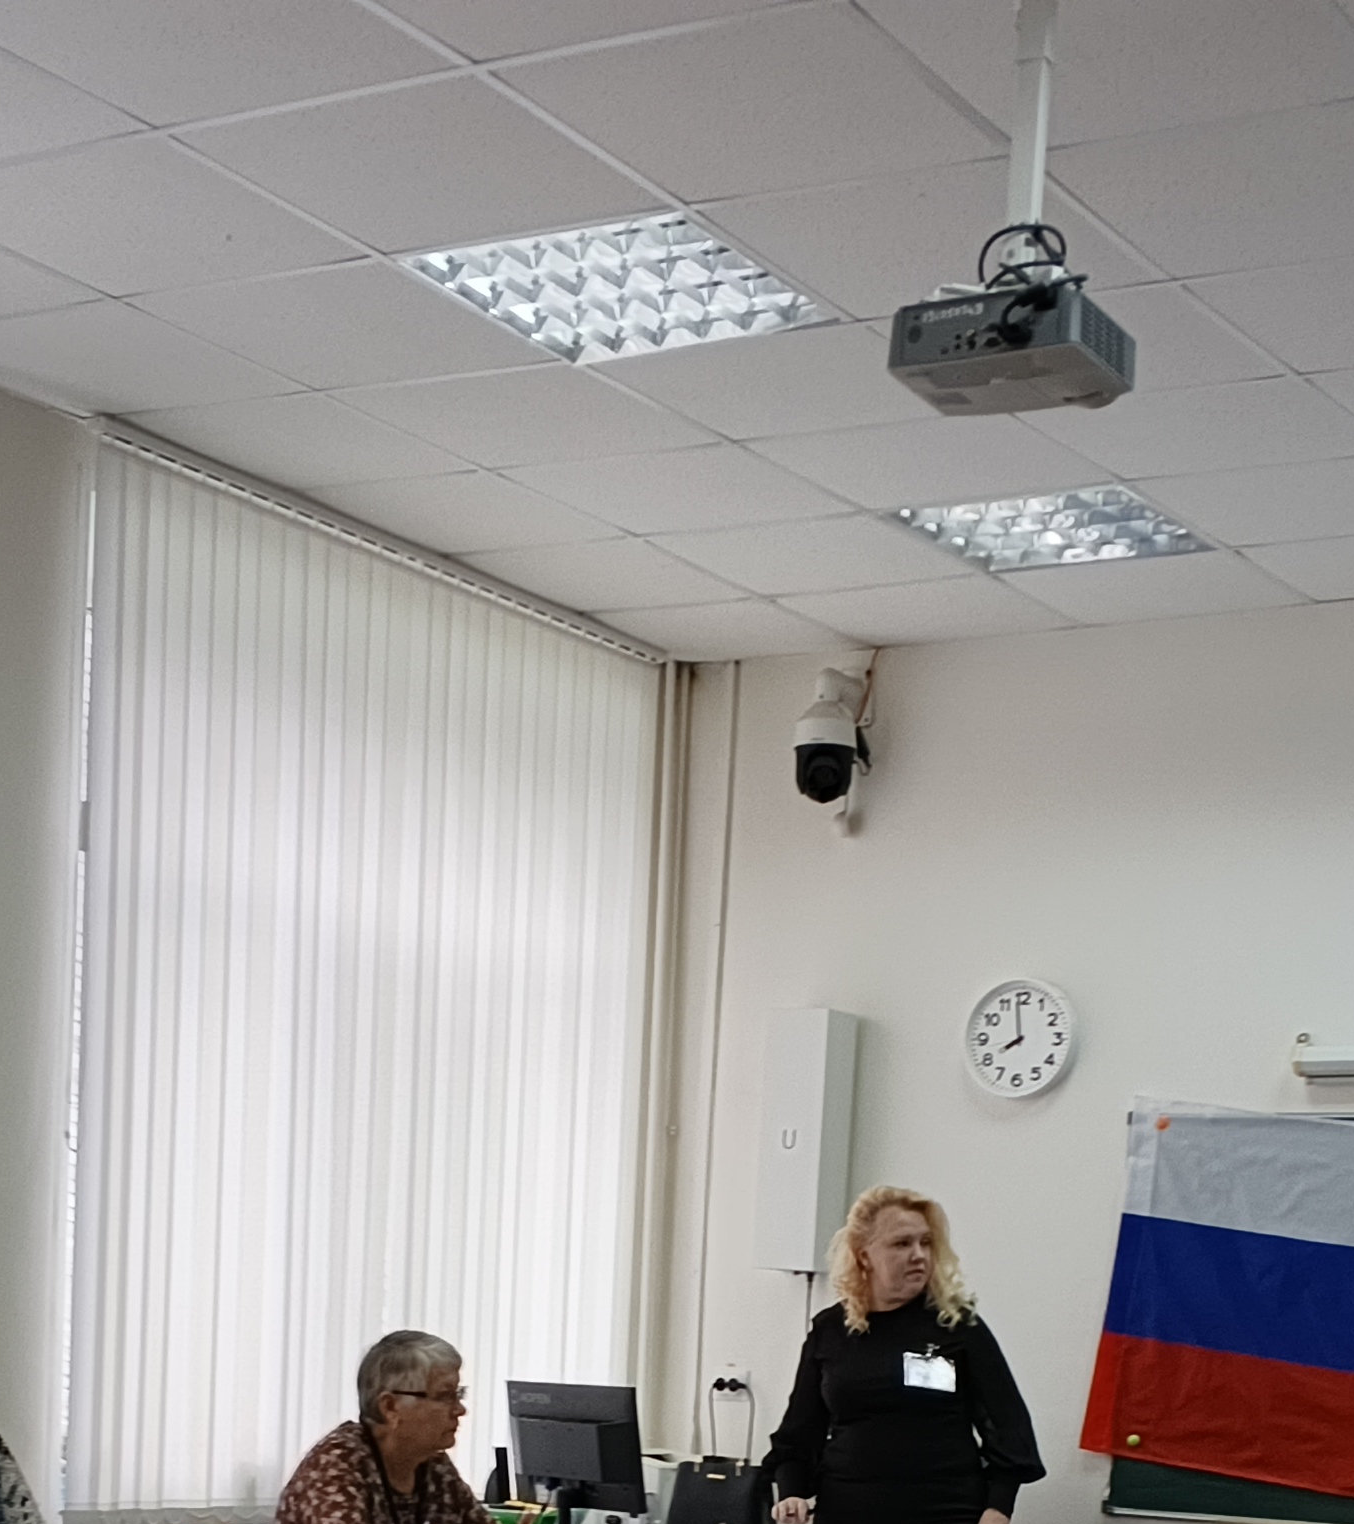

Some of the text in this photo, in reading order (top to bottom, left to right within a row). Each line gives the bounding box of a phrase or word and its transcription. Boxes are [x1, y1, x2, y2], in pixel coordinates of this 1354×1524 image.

[999, 998, 1011, 1011] 11
[1038, 998, 1045, 1011] 1
[984, 1013, 1001, 1027] 10
[1047, 1013, 1058, 1027] 2
[977, 1032, 990, 1046] 9
[1051, 1032, 1064, 1046] 3
[982, 1053, 994, 1067] 8
[1043, 1053, 1055, 1065] 4
[995, 1067, 1006, 1080] 7
[1010, 1073, 1024, 1087] 6
[1029, 1067, 1042, 1081] 5
